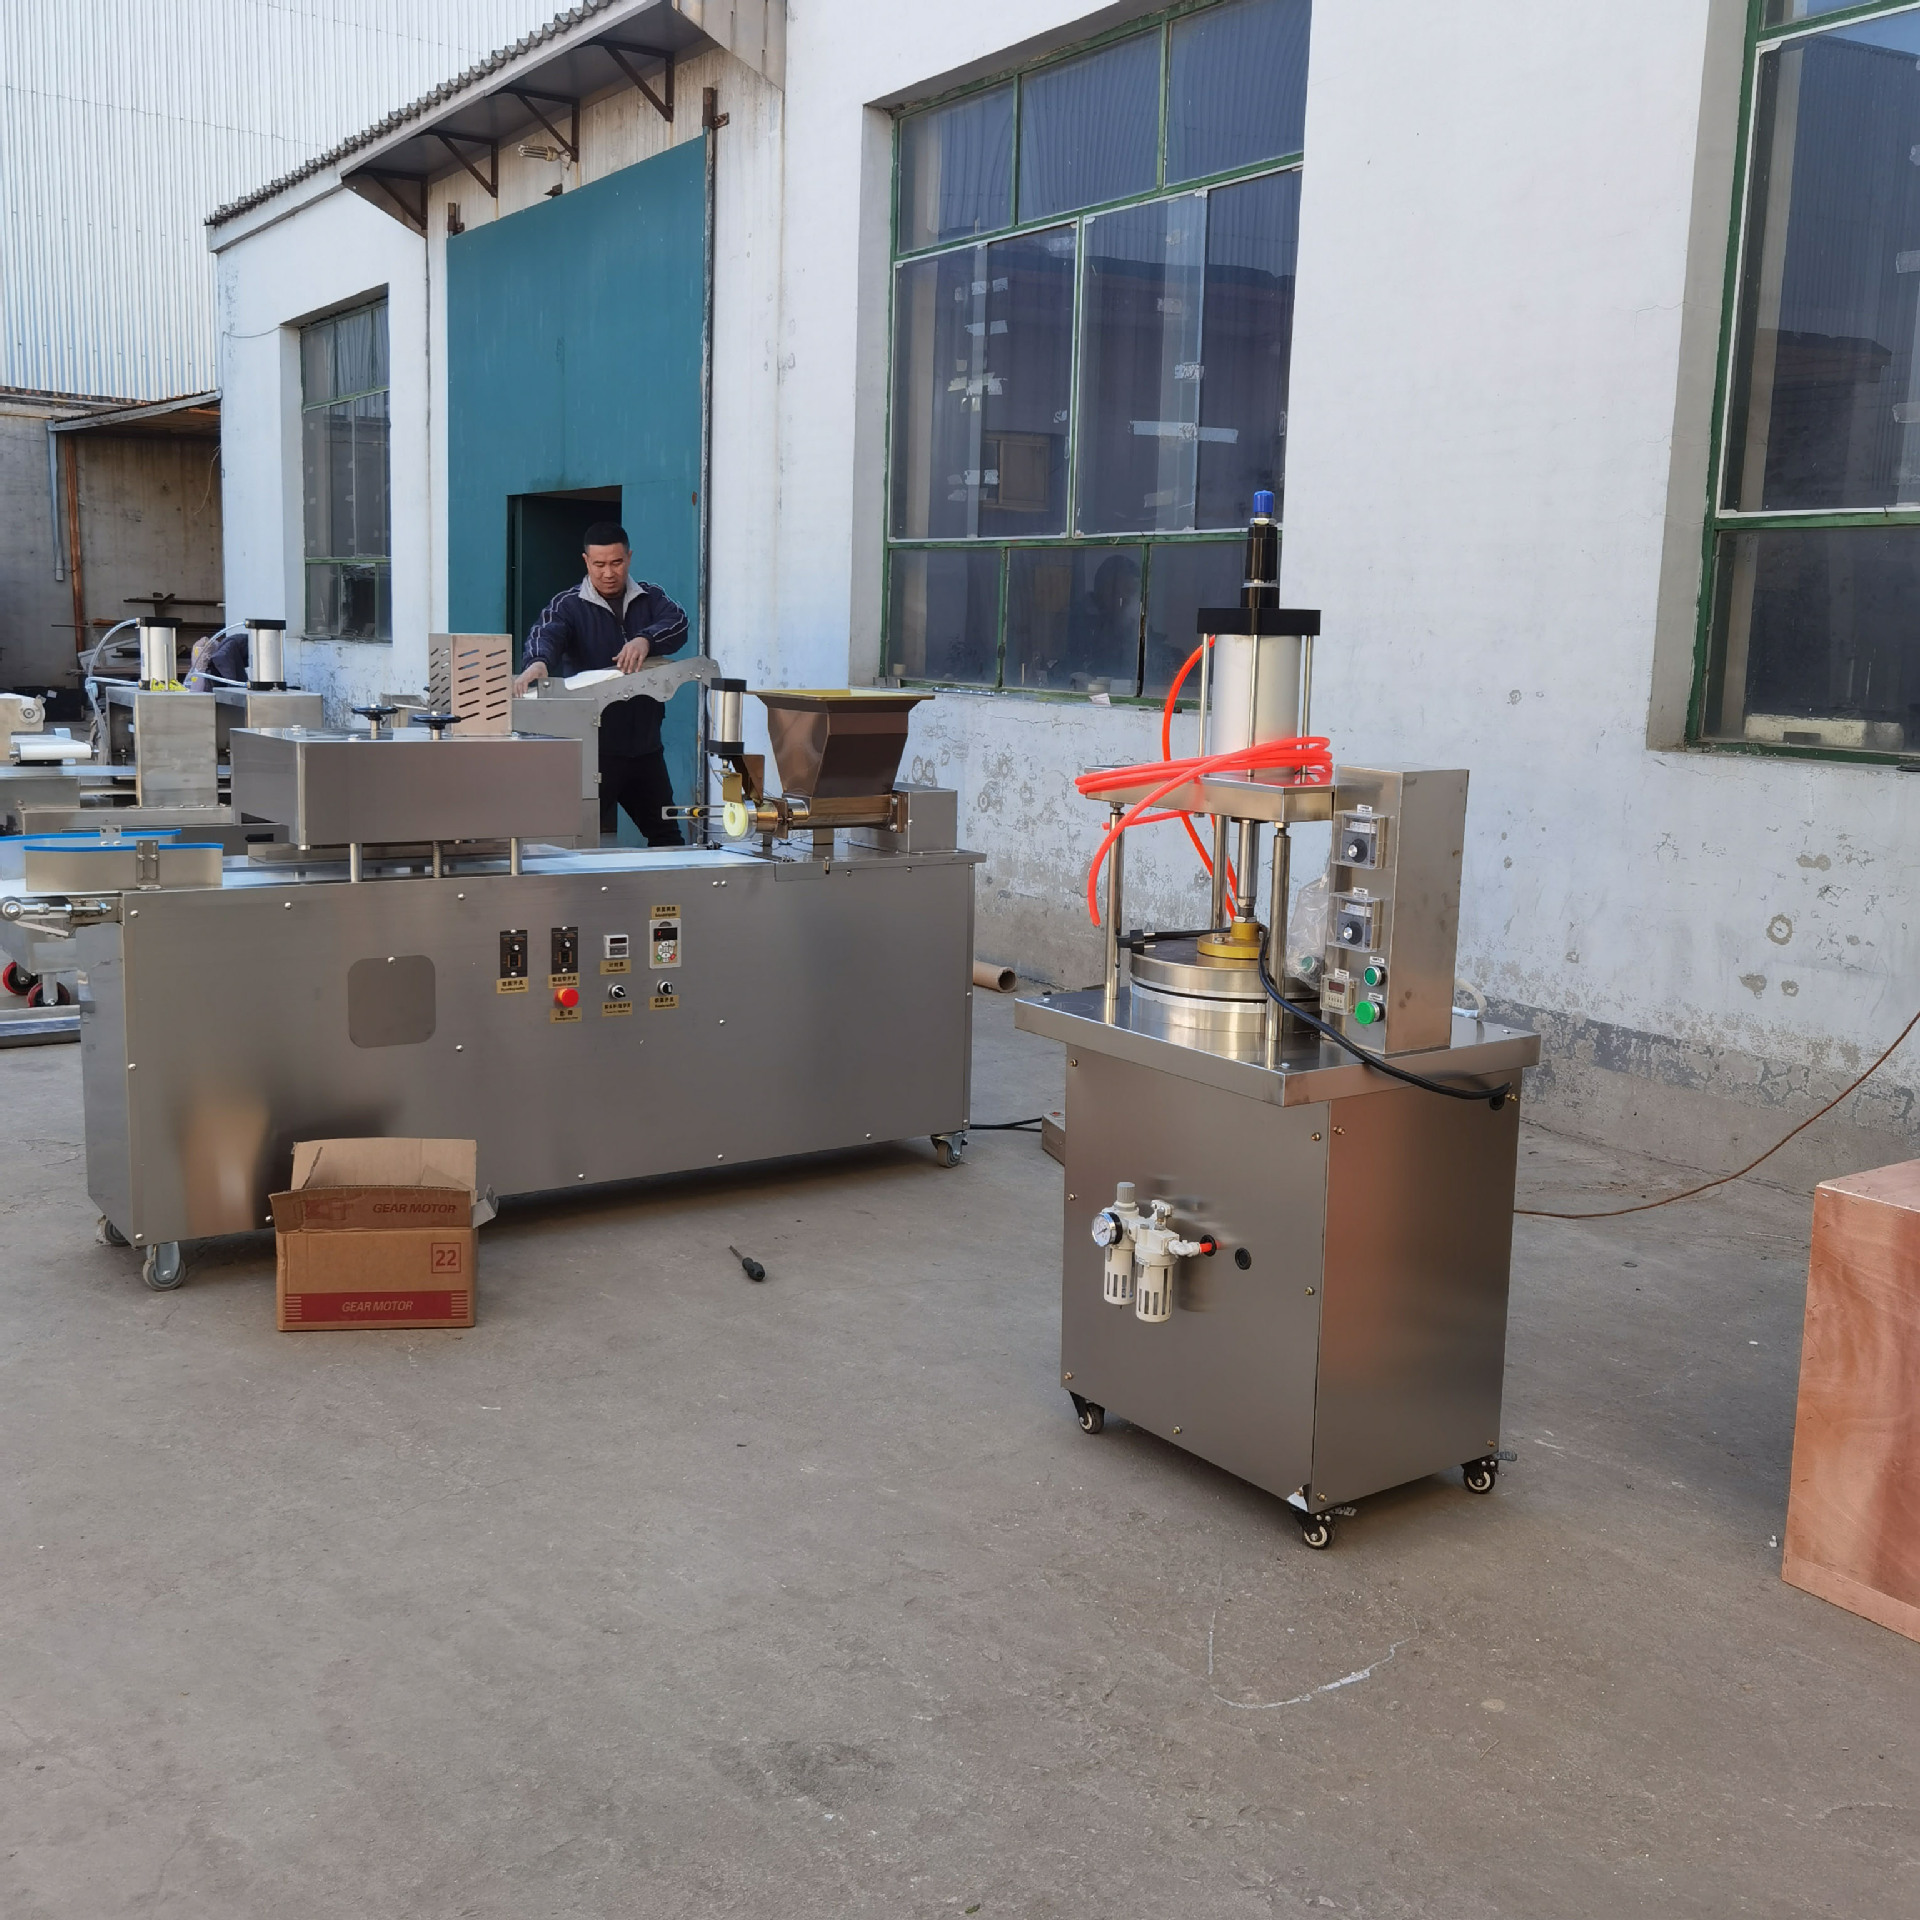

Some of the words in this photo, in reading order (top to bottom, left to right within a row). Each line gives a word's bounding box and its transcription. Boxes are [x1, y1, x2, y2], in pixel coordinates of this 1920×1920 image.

[373, 1203, 407, 1214] GEAR
[409, 1203, 457, 1214] MOTOR
[436, 1249, 457, 1266] 22
[342, 1301, 372, 1312] GEAR
[373, 1300, 414, 1312] MOTOR
